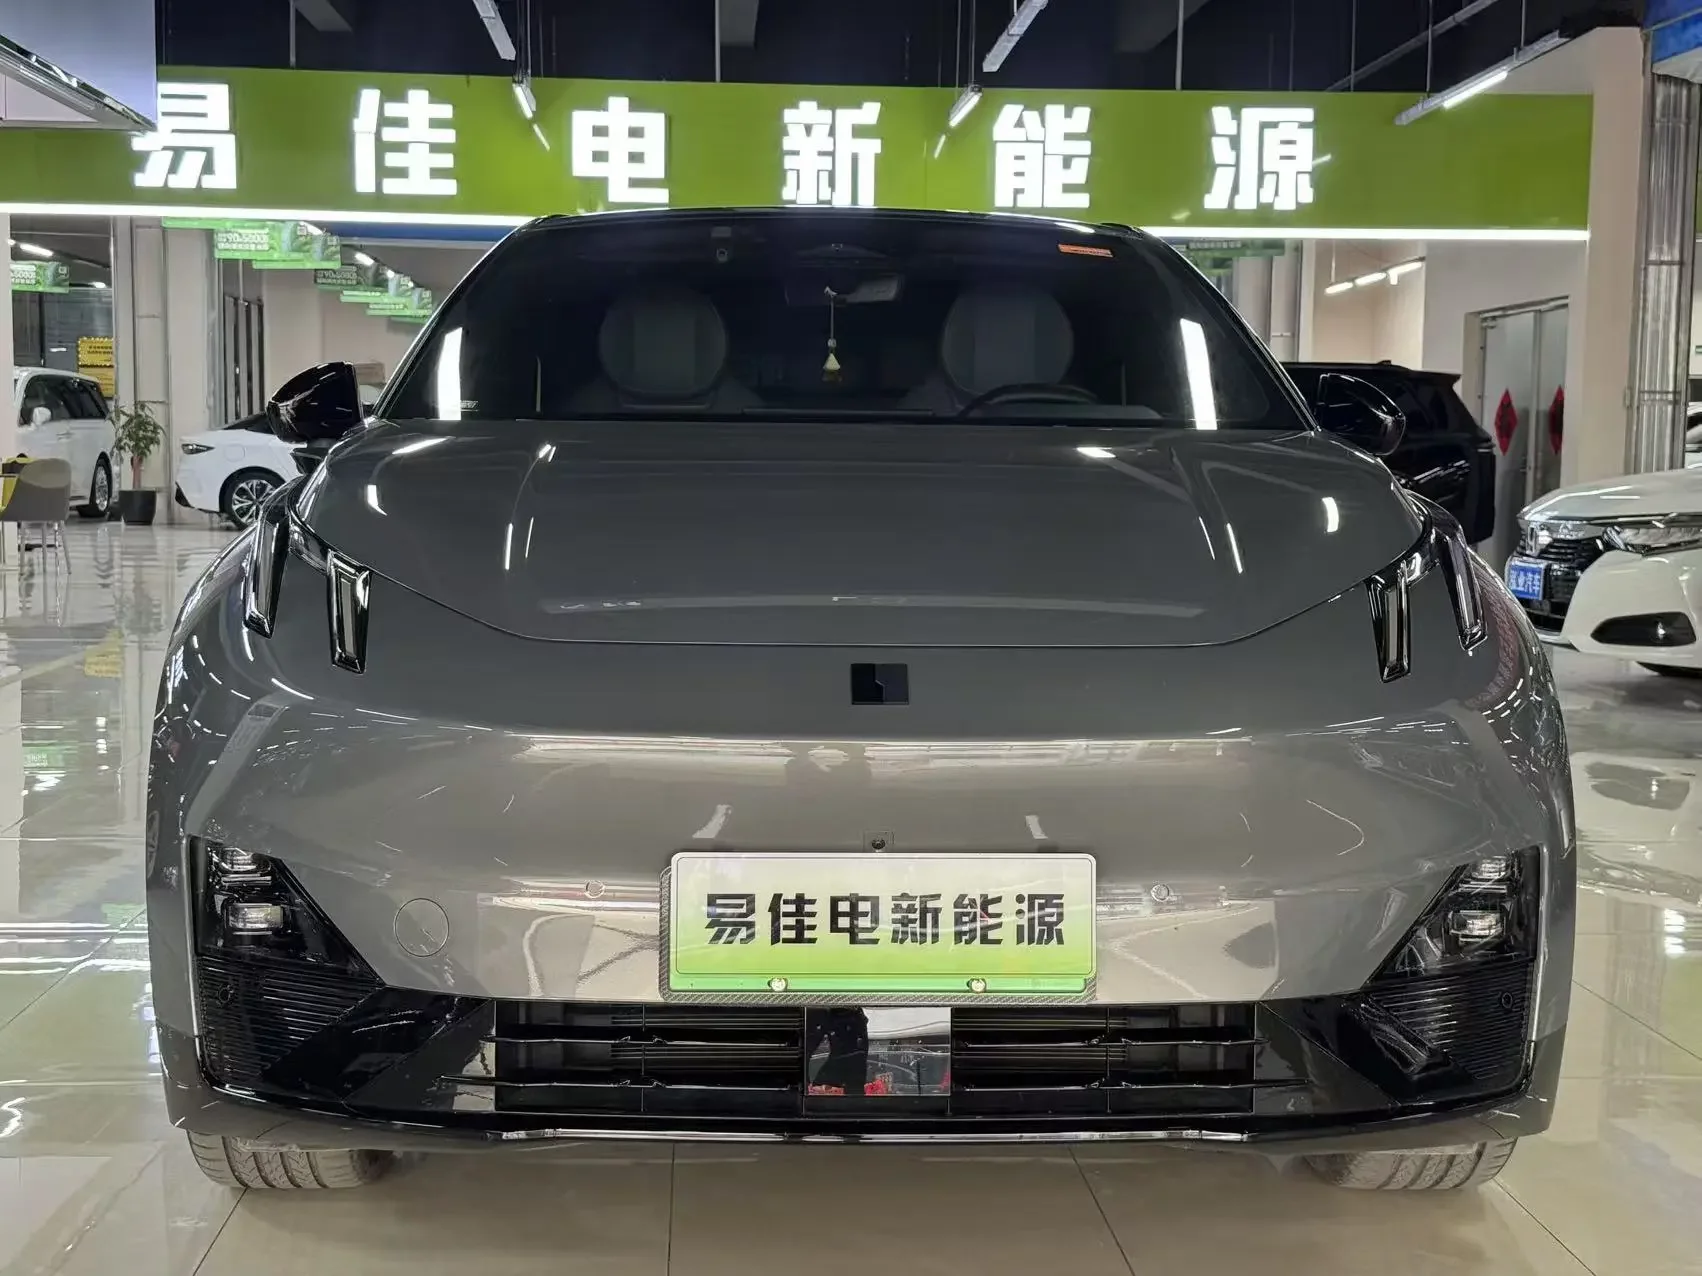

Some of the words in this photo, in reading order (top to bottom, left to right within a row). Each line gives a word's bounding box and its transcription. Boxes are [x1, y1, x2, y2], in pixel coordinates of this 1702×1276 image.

[131, 81, 1315, 211] 易佳电新能源
[704, 891, 1066, 946] 易佳电新能源
